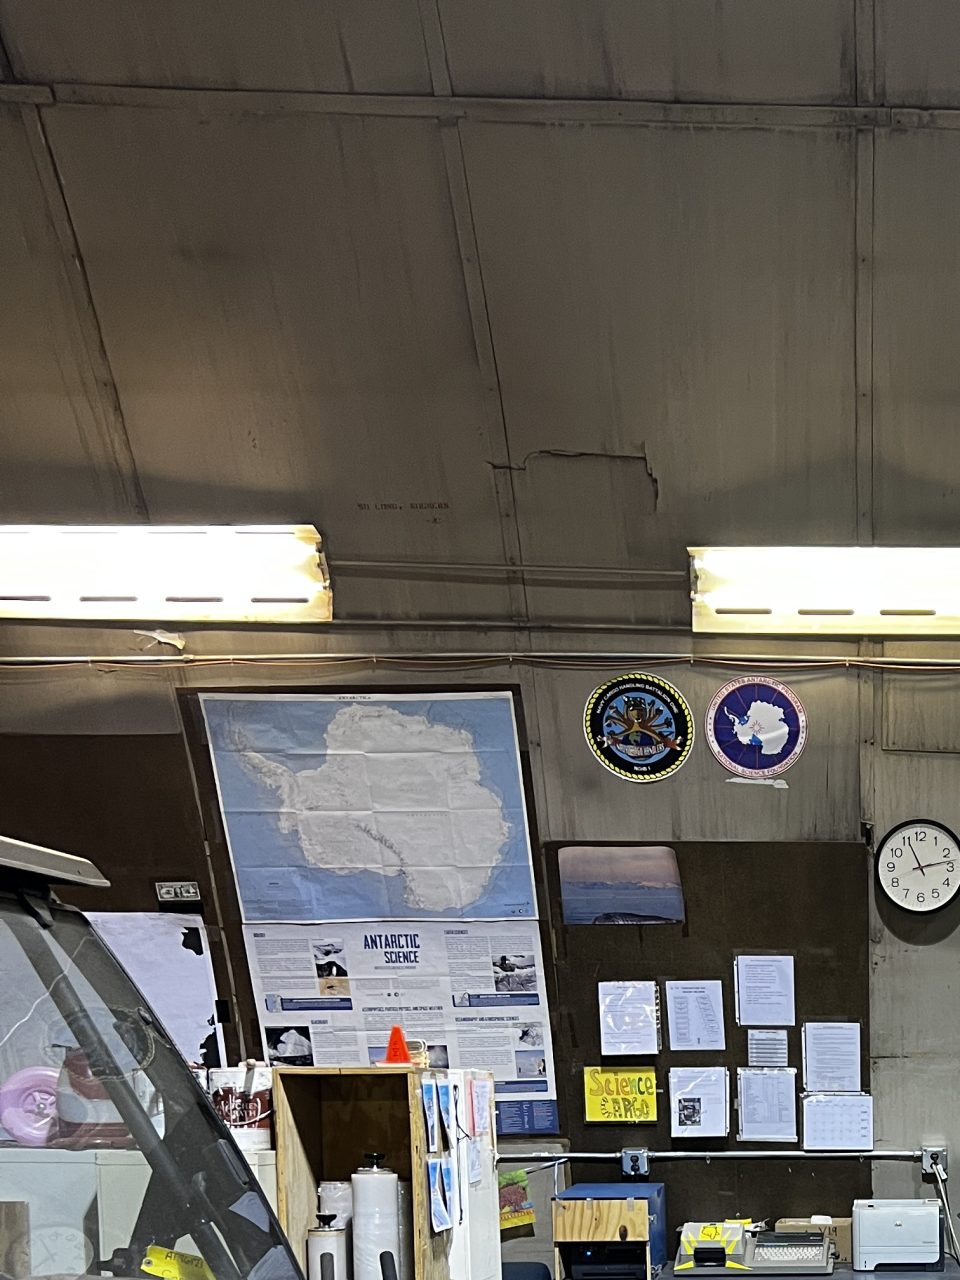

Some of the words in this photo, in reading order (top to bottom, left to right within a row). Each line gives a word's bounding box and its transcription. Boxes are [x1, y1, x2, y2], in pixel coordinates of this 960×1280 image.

[603, 687, 620, 701] CARGO
[645, 684, 671, 703] BATTALION
[711, 693, 725, 711] UNITED
[724, 678, 746, 693] STATES
[746, 677, 781, 689] ANTARCTIC
[781, 686, 803, 713] PROGRAM
[717, 750, 740, 771] NATIONAL
[767, 751, 798, 774] FOUNDATION
[902, 836, 911, 846] 11
[915, 831, 927, 842] 12
[934, 836, 938, 846] 1
[890, 848, 903, 858] 10
[942, 848, 951, 858] 2
[886, 862, 896, 872] 9
[946, 861, 955, 872] 3
[891, 877, 900, 888] 8
[942, 877, 951, 887] 4
[902, 888, 910, 899] 7
[916, 892, 925, 903] 6
[931, 888, 940, 899] 5
[363, 933, 421, 950] ANTARCTIC
[384, 950, 420, 964] SCIENCE
[589, 1068, 654, 1096] Science
